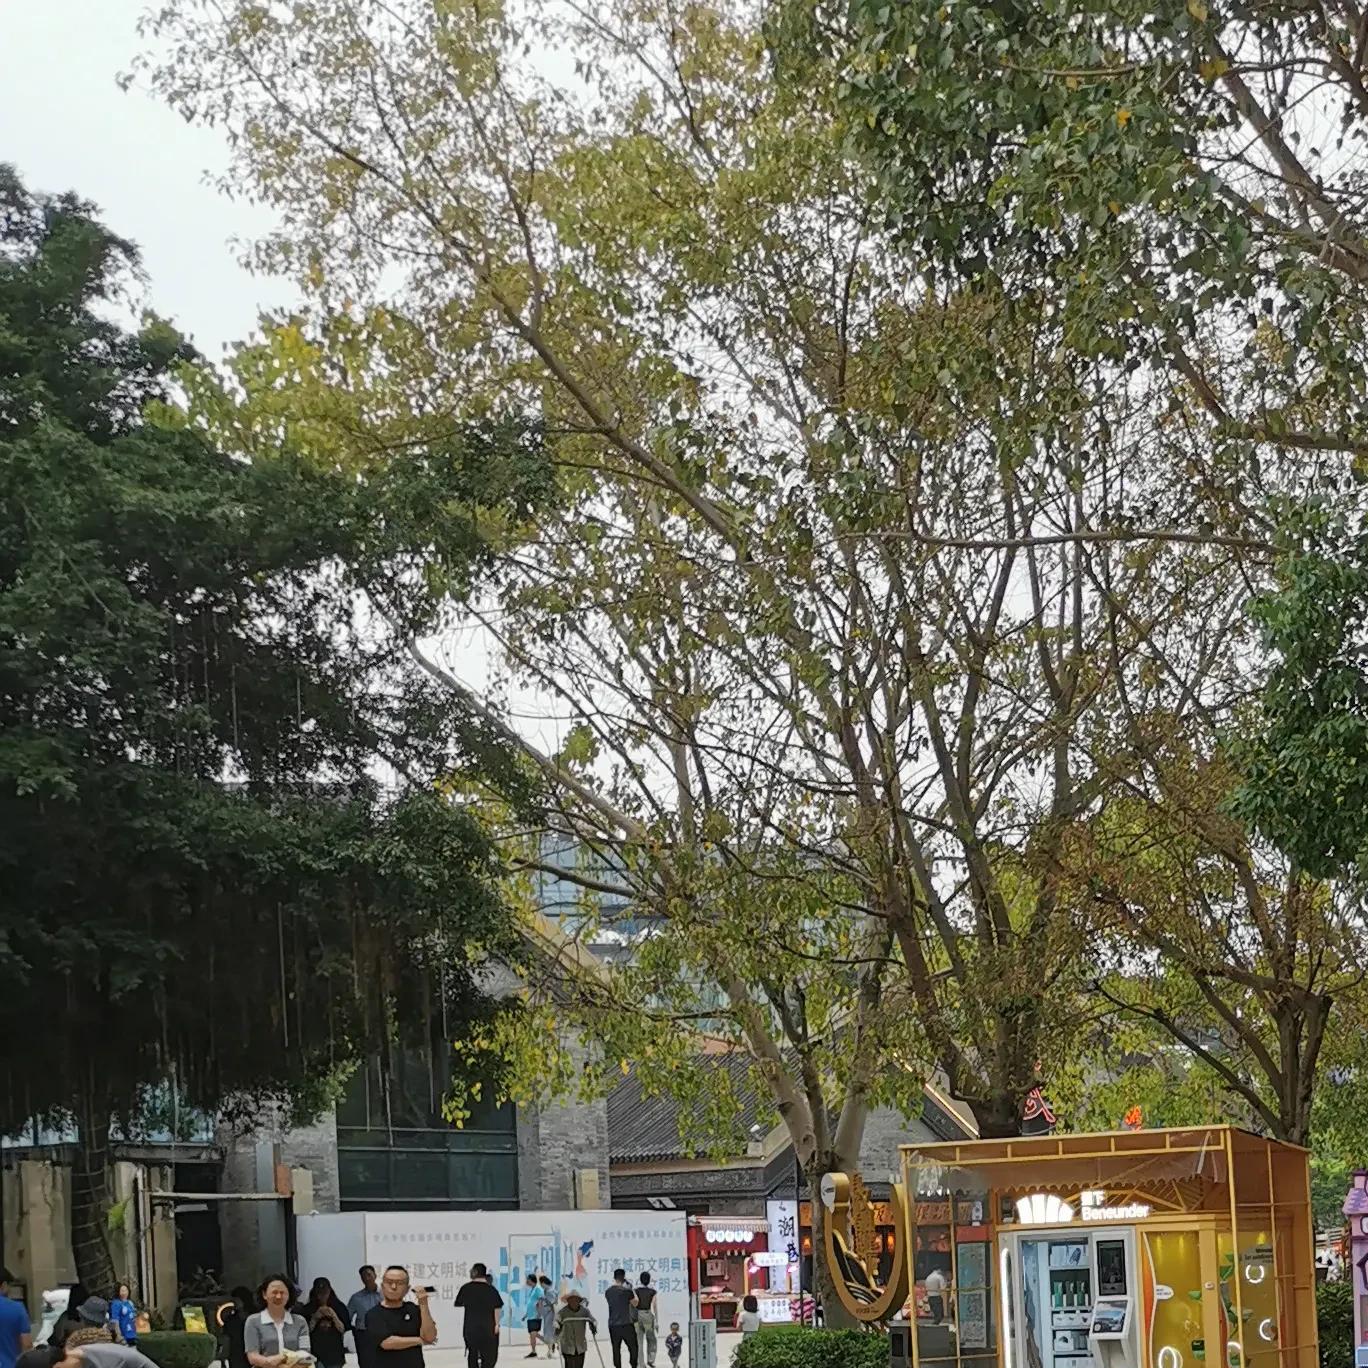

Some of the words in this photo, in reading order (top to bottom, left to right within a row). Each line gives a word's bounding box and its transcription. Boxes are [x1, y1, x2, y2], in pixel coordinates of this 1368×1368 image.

[1081, 1203, 1150, 1221] Beneunder
[598, 1256, 686, 1274] 打造城市文明典
